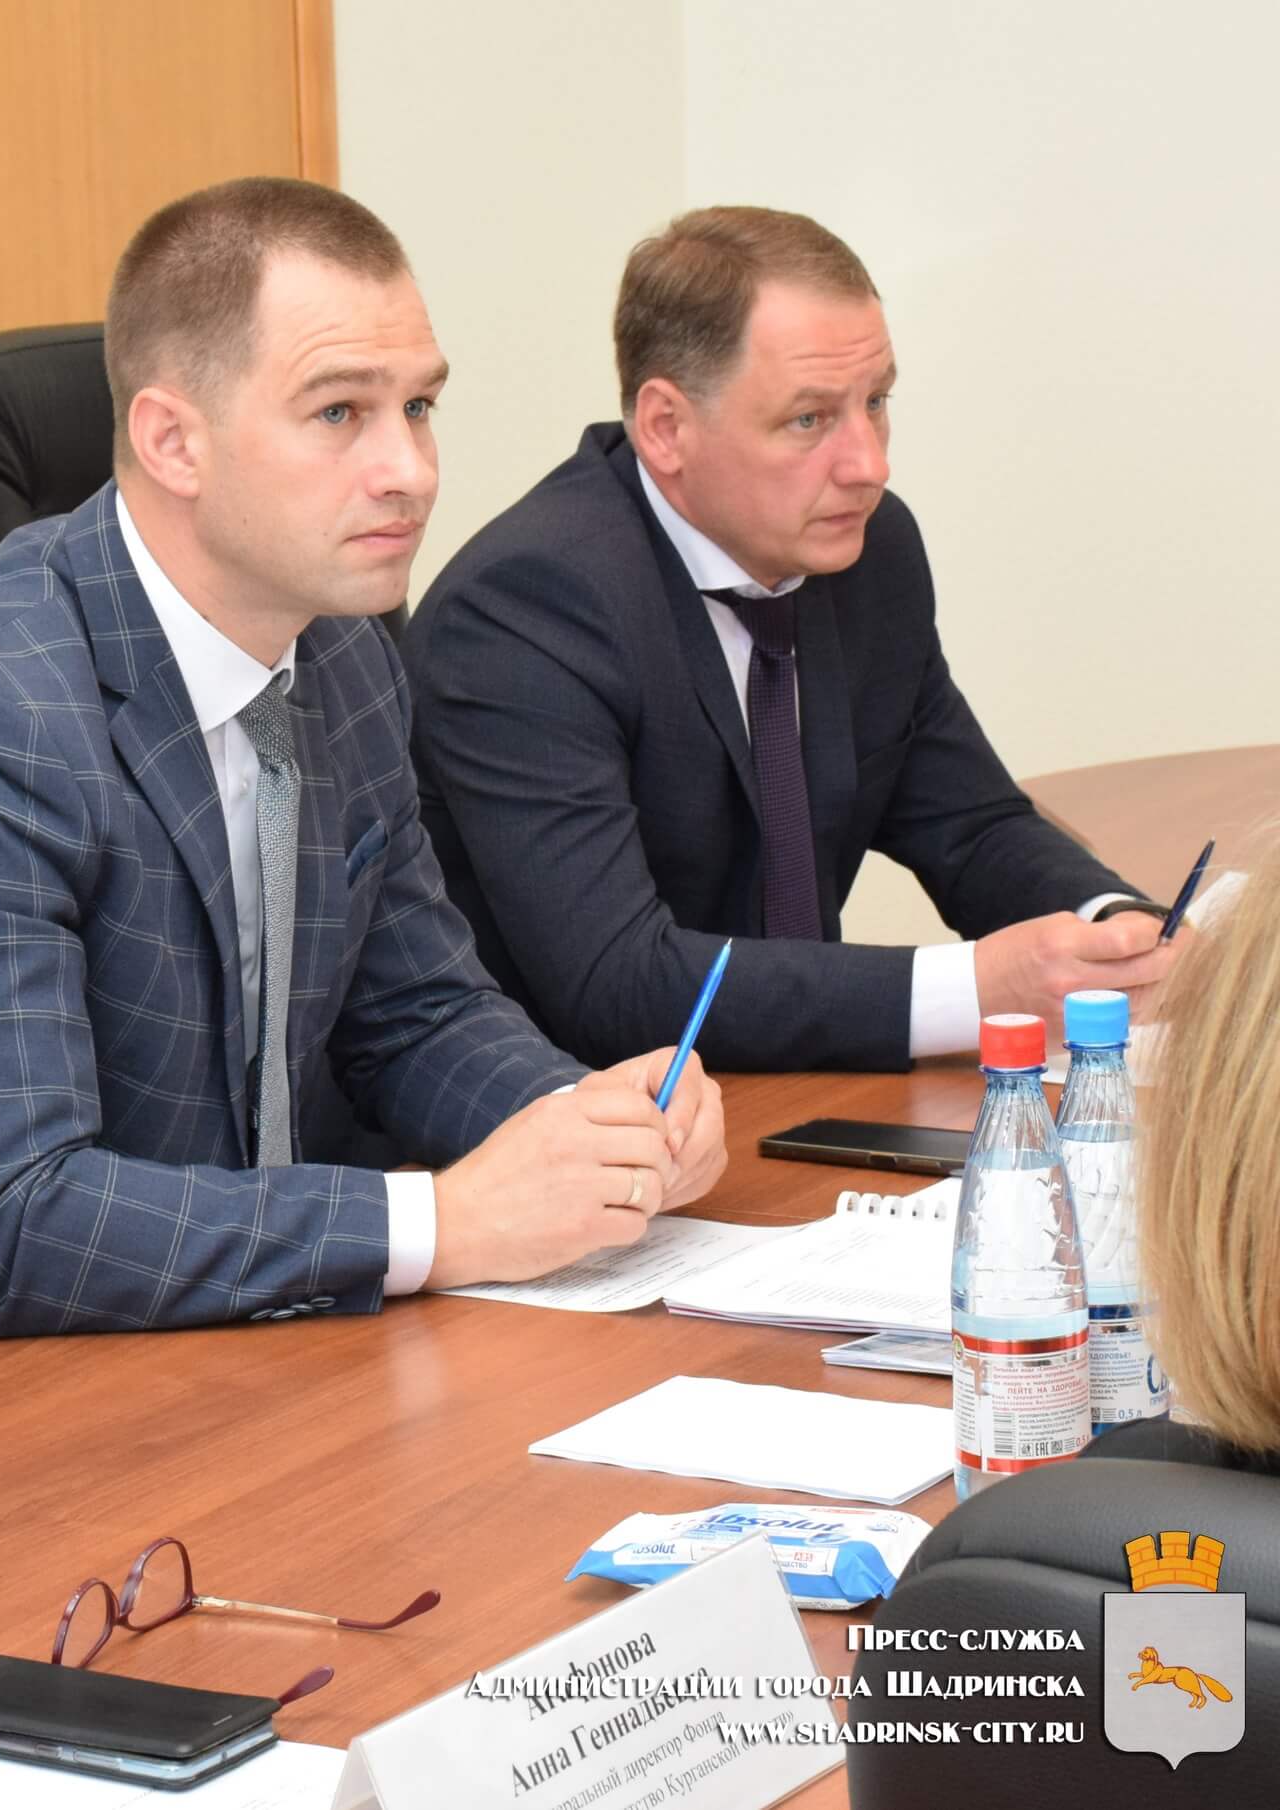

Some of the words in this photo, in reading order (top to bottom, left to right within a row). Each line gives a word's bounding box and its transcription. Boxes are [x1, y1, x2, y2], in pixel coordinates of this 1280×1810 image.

[510, 1746, 572, 1798] Анна
[624, 1736, 683, 1783] директор
[683, 1711, 727, 1743] Фонда
[663, 1740, 741, 1797] Курганской
